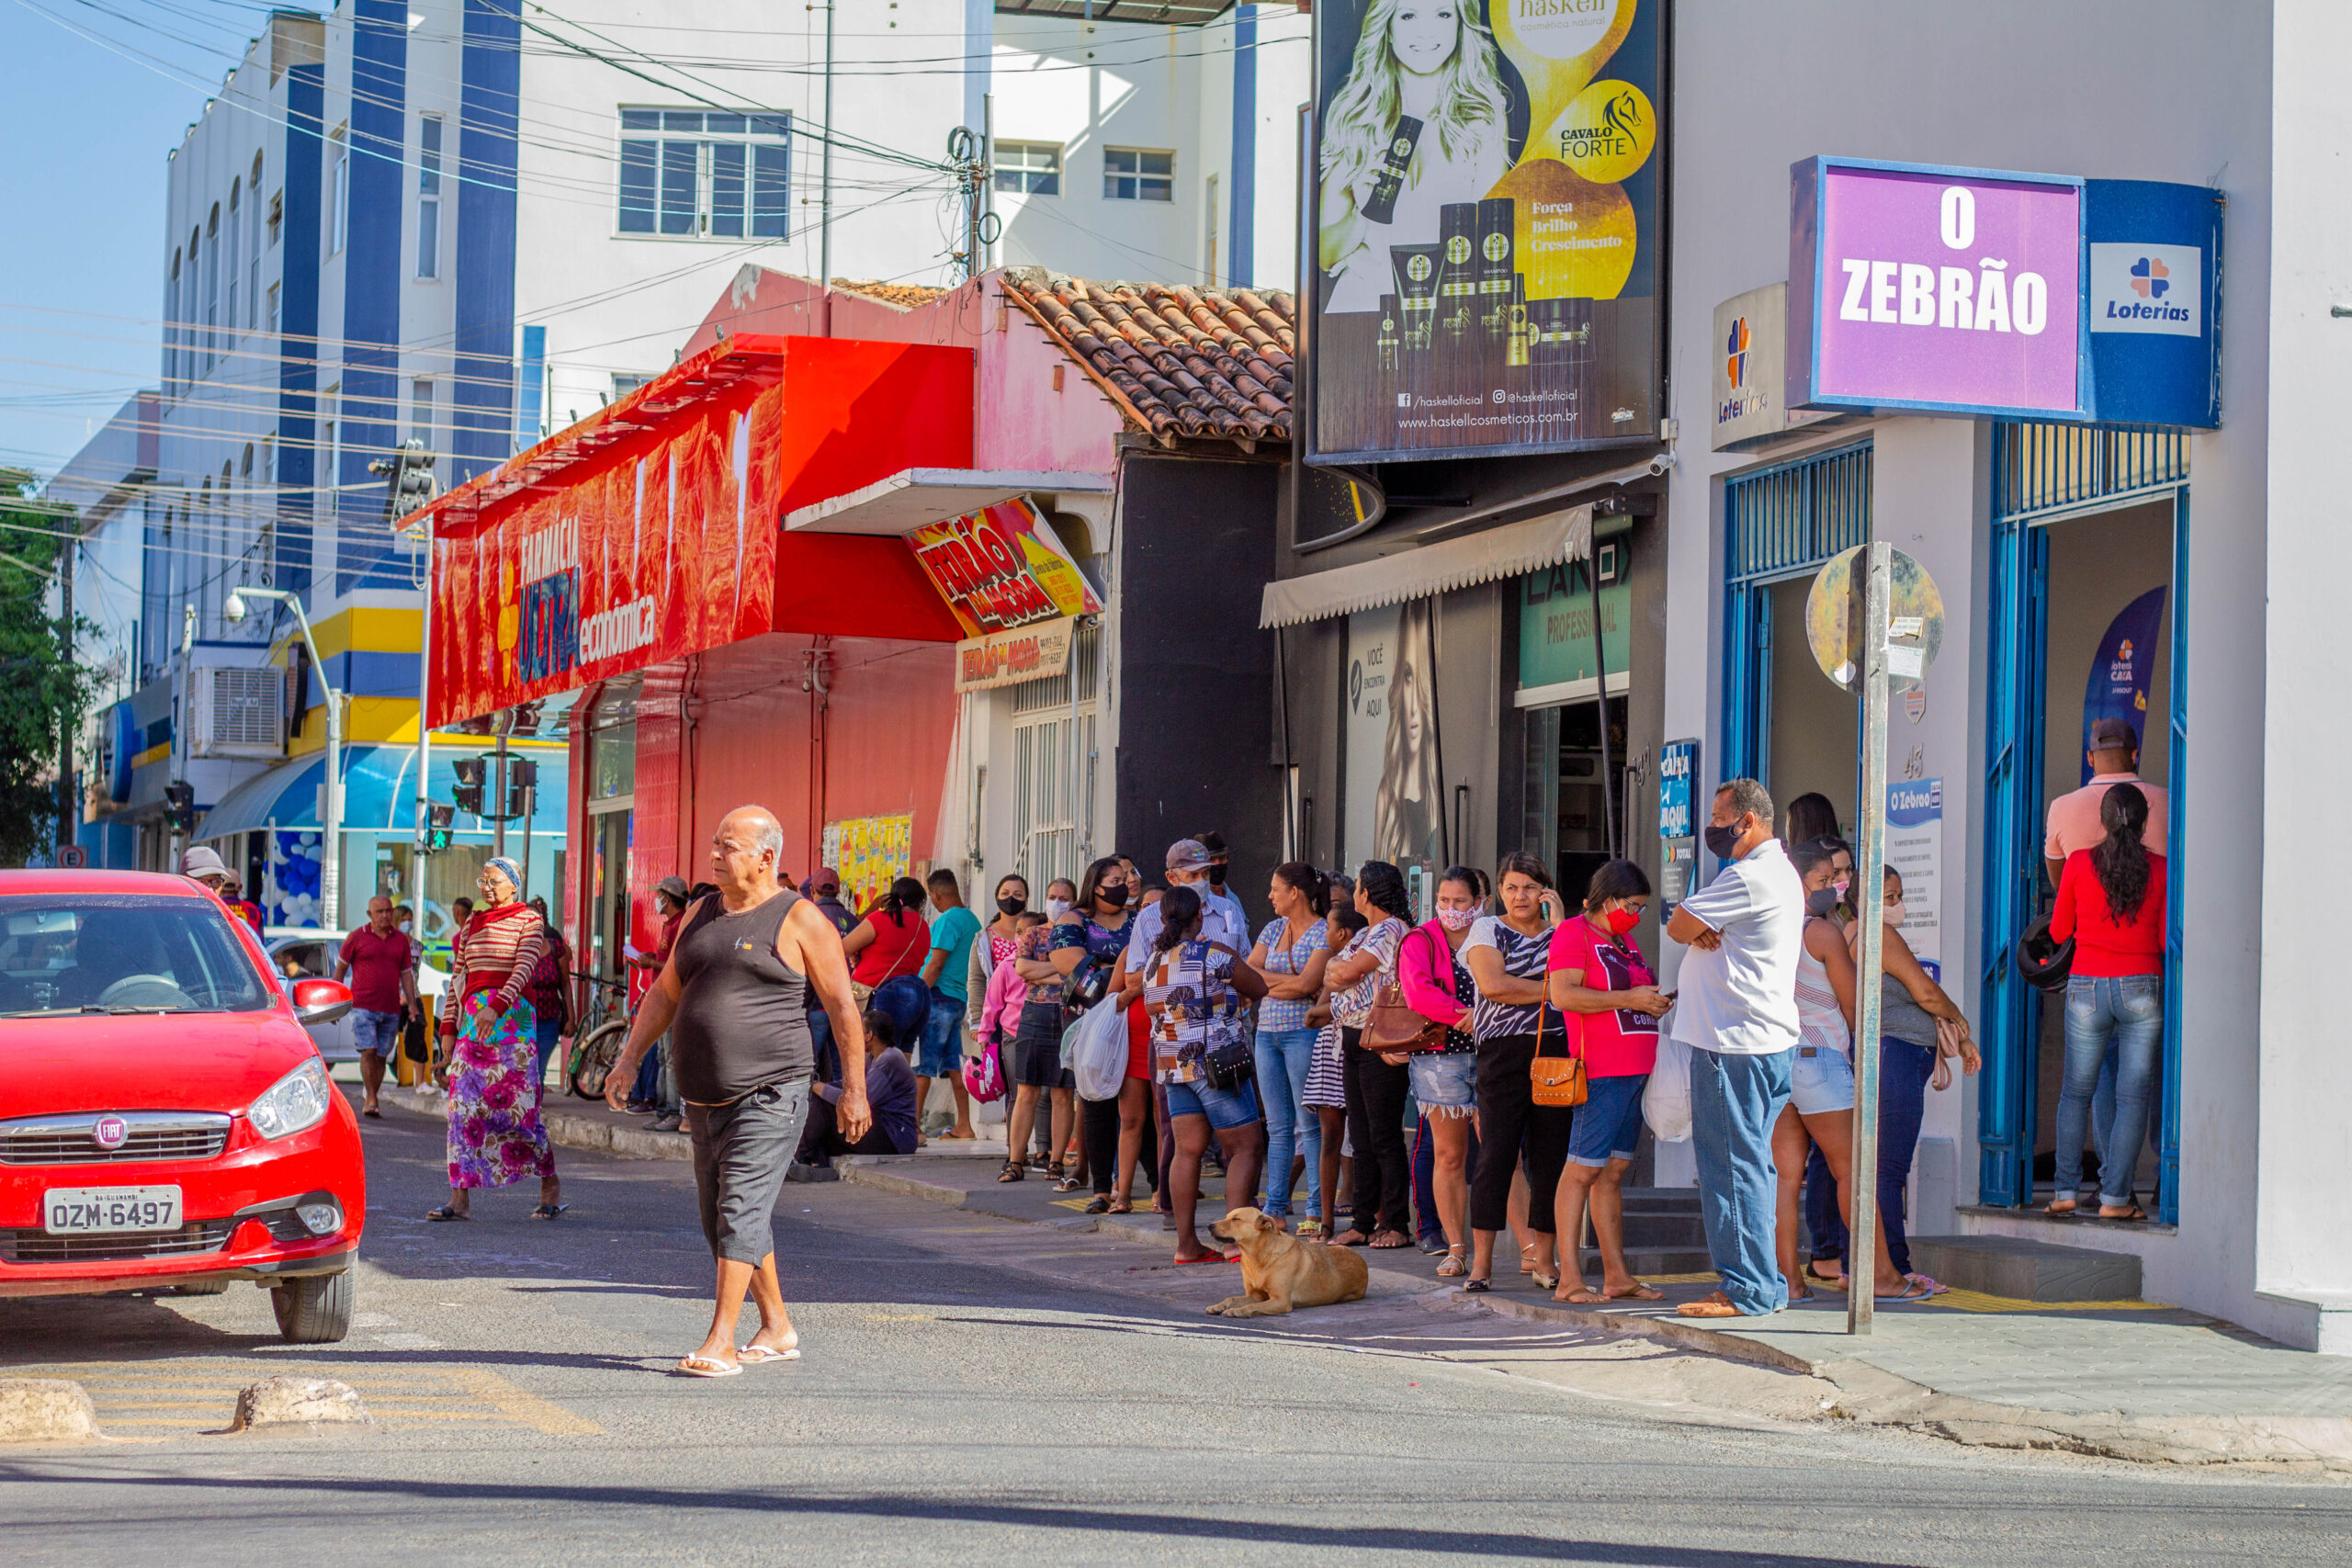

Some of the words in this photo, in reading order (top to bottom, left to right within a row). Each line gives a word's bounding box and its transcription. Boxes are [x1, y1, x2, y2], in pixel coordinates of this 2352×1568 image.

[1521, 20, 1569, 31] cosmética
[1572, 16, 1605, 28] natural
[1561, 127, 1612, 140] CAVALO
[1561, 138, 1626, 159] FORTE
[1532, 202, 1573, 215] Força
[1940, 186, 1975, 251] O
[1532, 218, 1577, 233] Brilho
[1532, 236, 1623, 252] Crescimento
[1839, 256, 2048, 336] ZEBRÃO
[2106, 299, 2190, 323] Loterias
[1413, 393, 1483, 411] /haskelloficial
[1508, 389, 1577, 404] @haskelloficial
[1397, 408, 1578, 429] www.haskellcosmeticos.com.br
[521, 509, 579, 588] FARMÁCIA
[917, 516, 1020, 602] FEIRÃO
[966, 589, 996, 623] DA
[988, 570, 1059, 628] MODA
[519, 566, 581, 684] ULTRA
[580, 589, 655, 666] econômica
[1547, 603, 1617, 645] PROFESSINAL
[962, 637, 999, 683] FEIRÃO
[1007, 636, 1040, 676] MODA
[1367, 642, 1384, 667] VOCÊ
[1363, 674, 1385, 690] ENCONTRA
[1366, 698, 1382, 718] AQUI
[1662, 755, 1690, 777] CAIXA
[1891, 792, 1899, 811] O
[1661, 805, 1687, 828] AQUI
[67, 852, 77, 865] E
[1676, 847, 1691, 860] TOTAL
[103, 1123, 121, 1139] FIAT
[52, 1201, 174, 1228] OZM-6497
